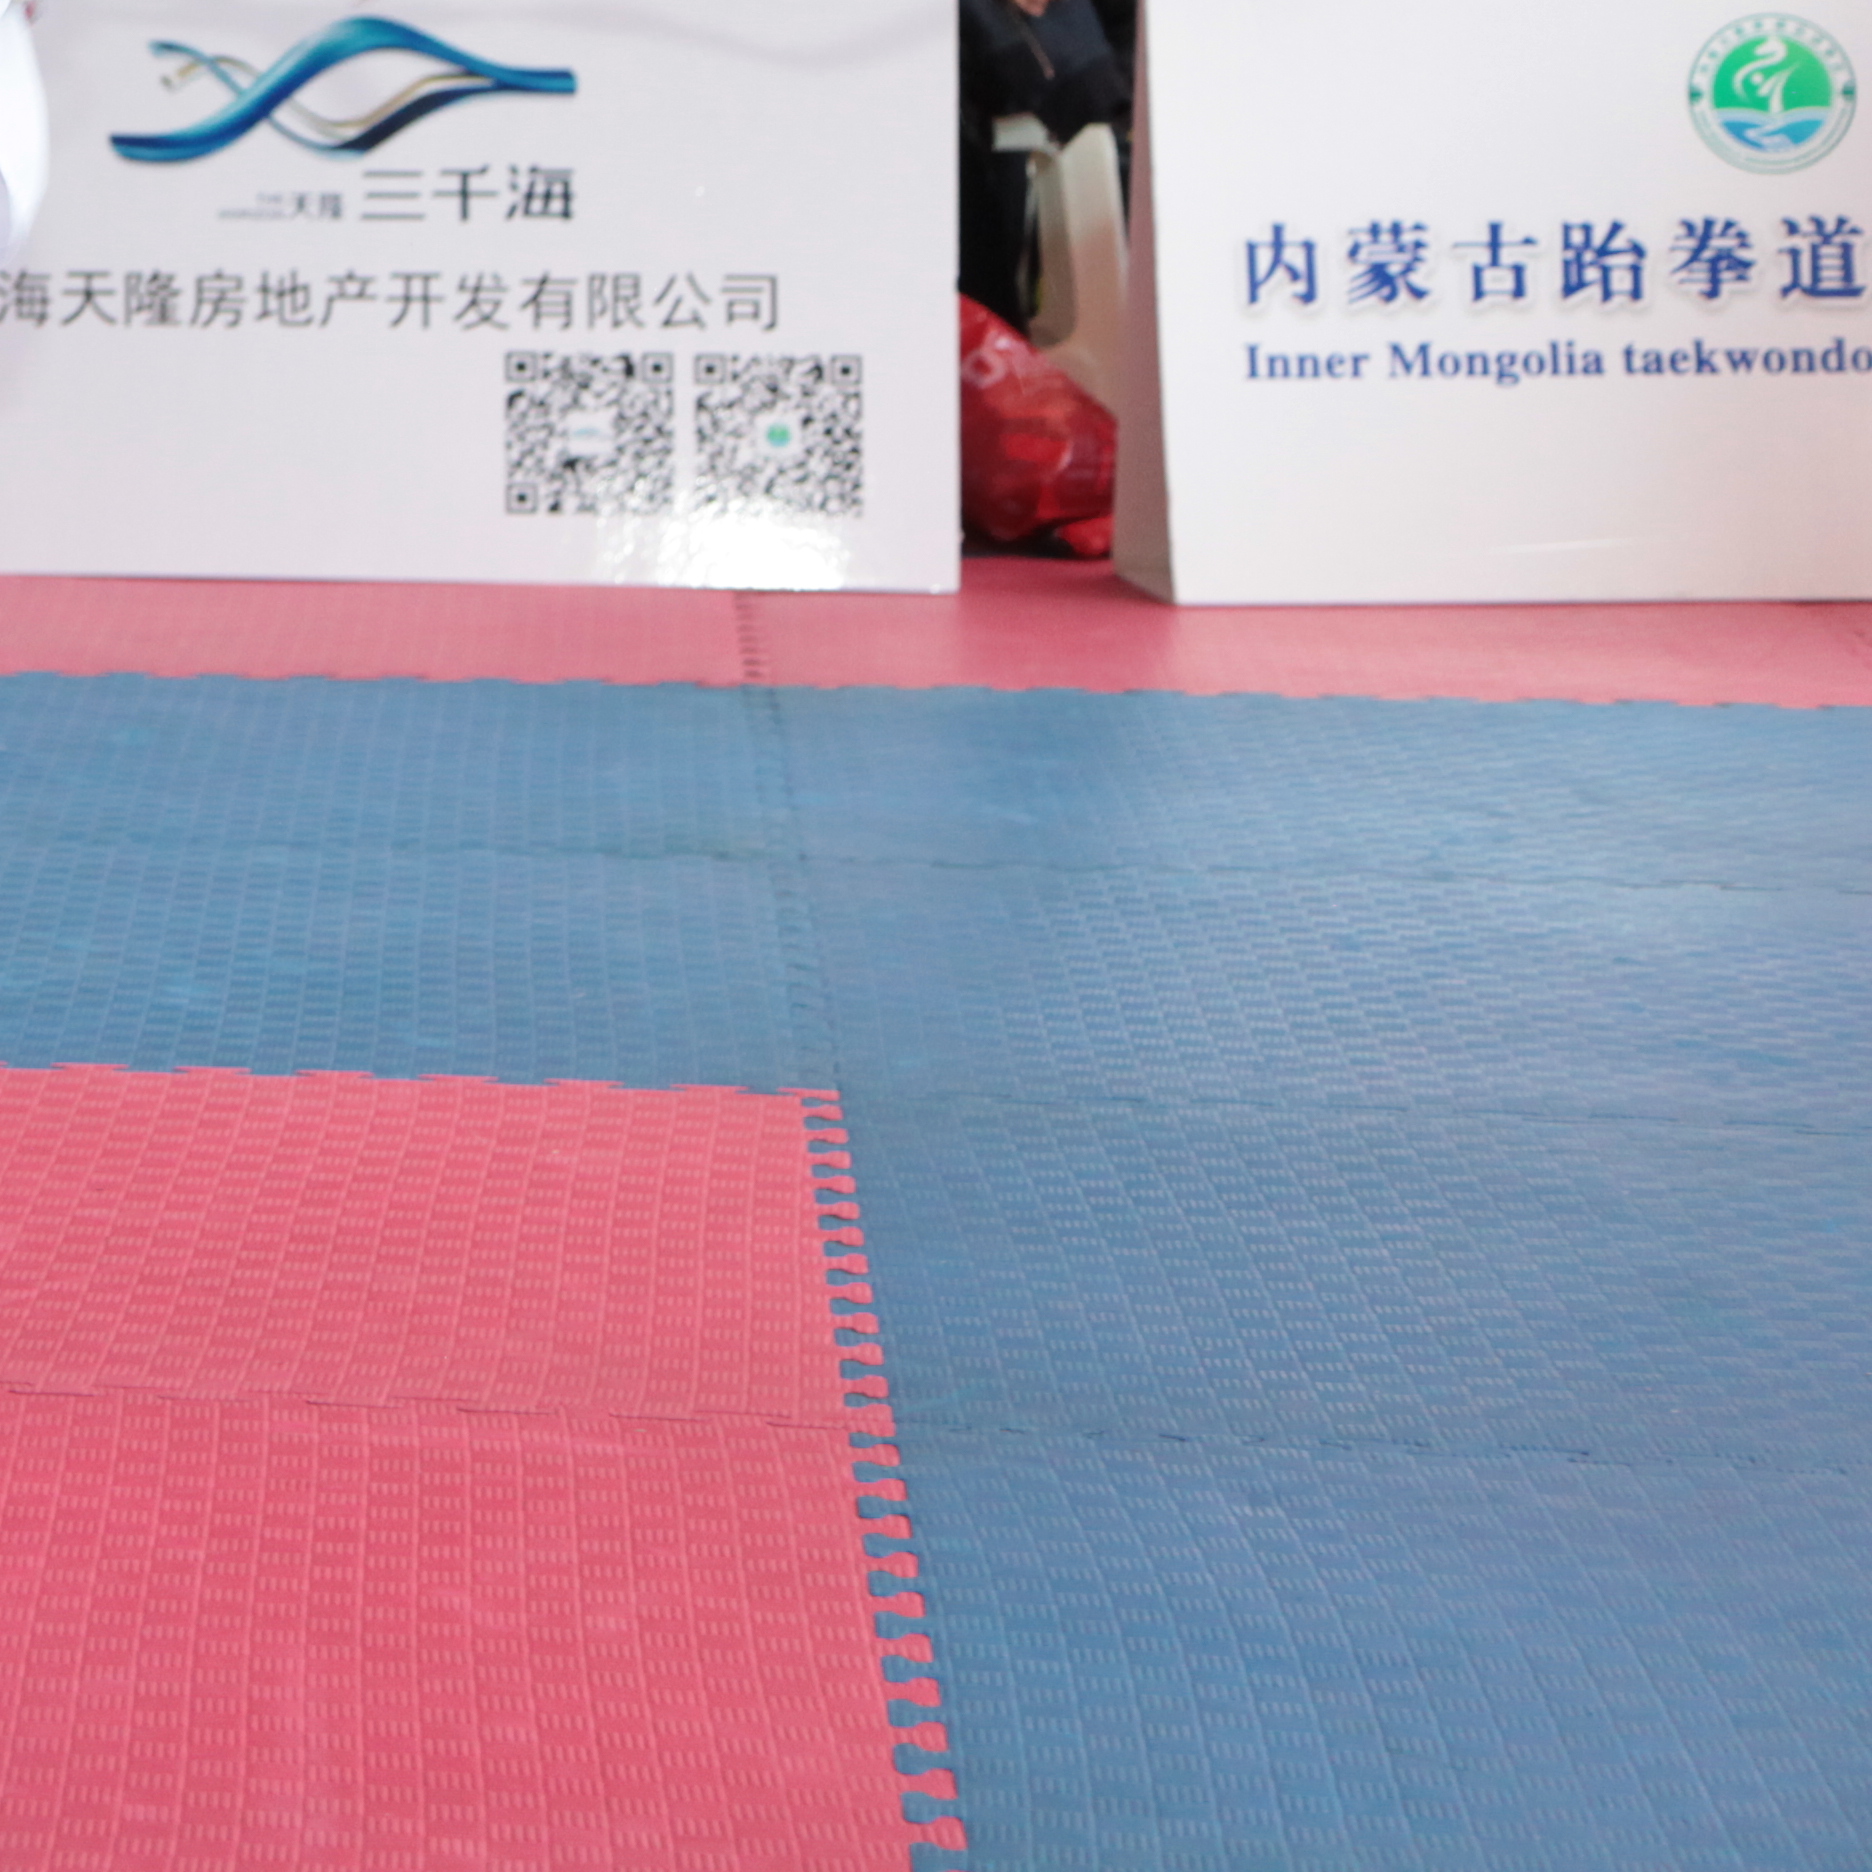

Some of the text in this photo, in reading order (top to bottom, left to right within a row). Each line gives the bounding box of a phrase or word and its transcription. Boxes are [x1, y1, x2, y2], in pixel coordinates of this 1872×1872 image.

[359, 164, 572, 221] 三千海
[1245, 217, 1867, 306] 内蒙古跆拳道
[1245, 336, 1872, 388] Inner Mongolia taekwondo
